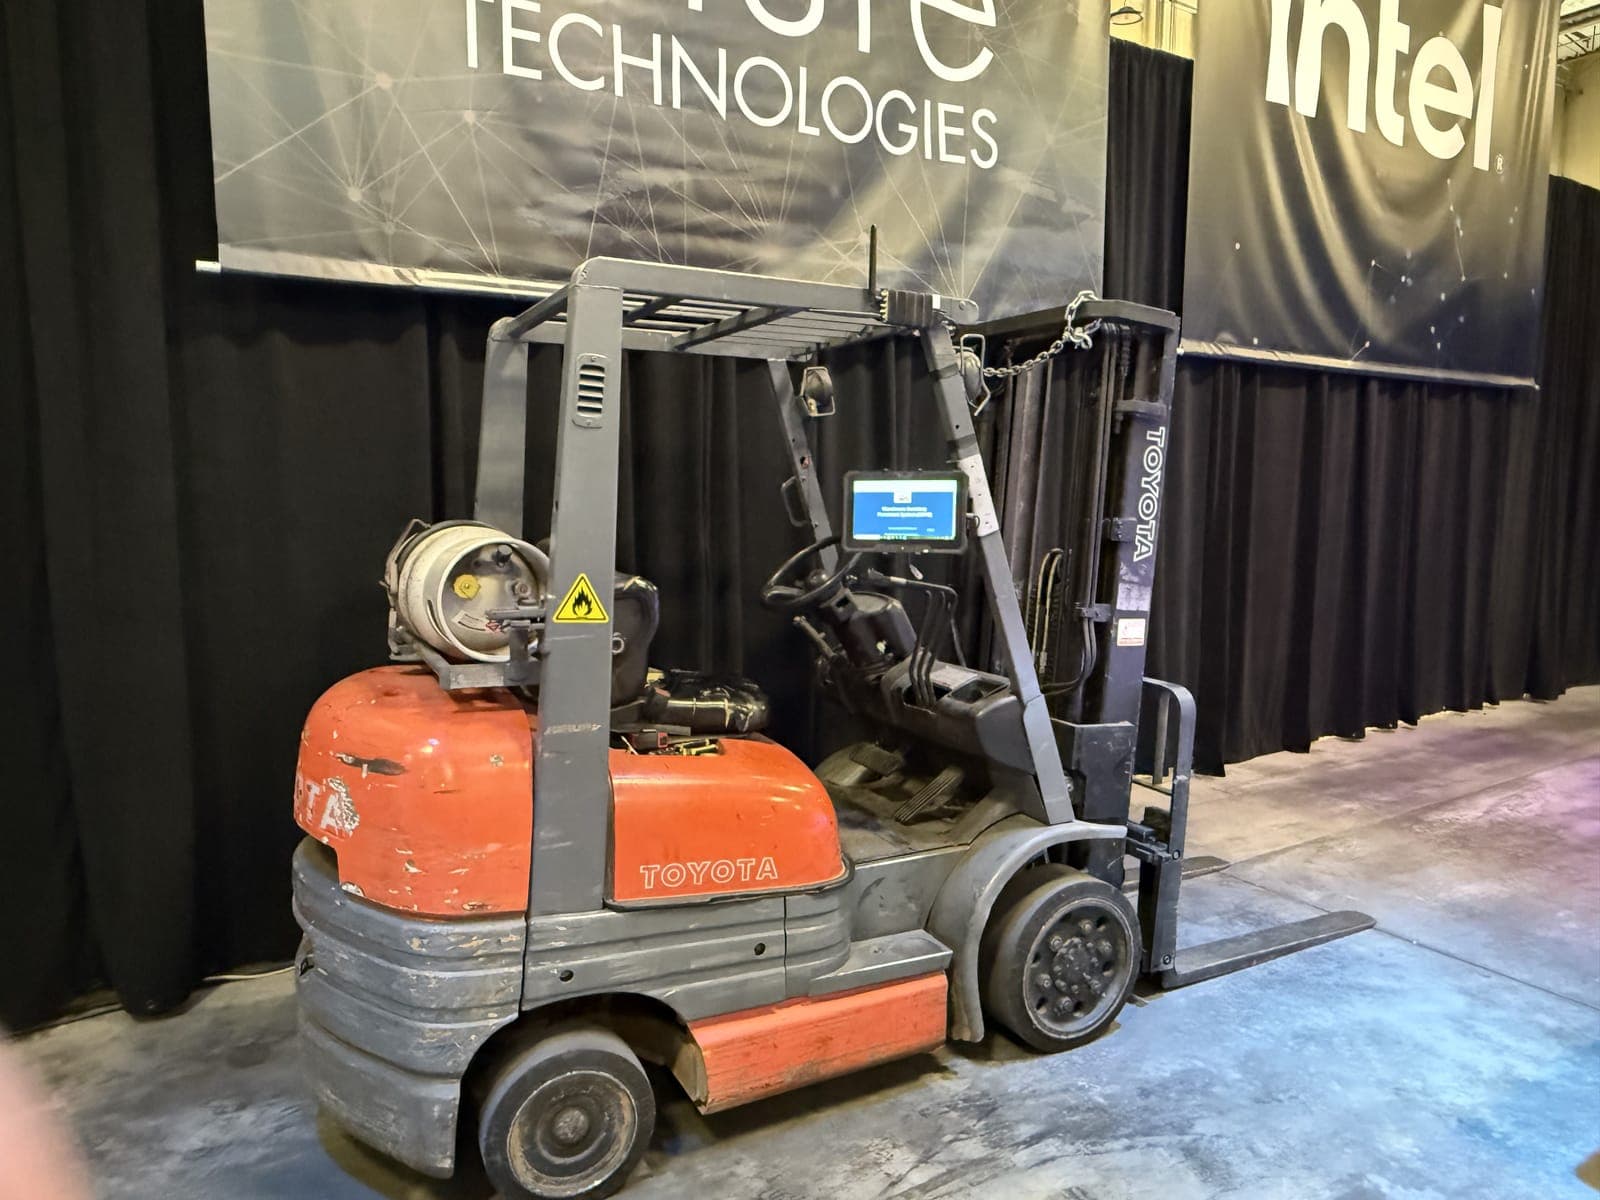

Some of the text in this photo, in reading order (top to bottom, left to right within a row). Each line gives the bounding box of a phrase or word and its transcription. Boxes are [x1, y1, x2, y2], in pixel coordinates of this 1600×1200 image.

[464, 0, 999, 170] TECHNOLOGIES
[1133, 426, 1166, 562] TOYOTA
[639, 856, 779, 890] TOYOTA
